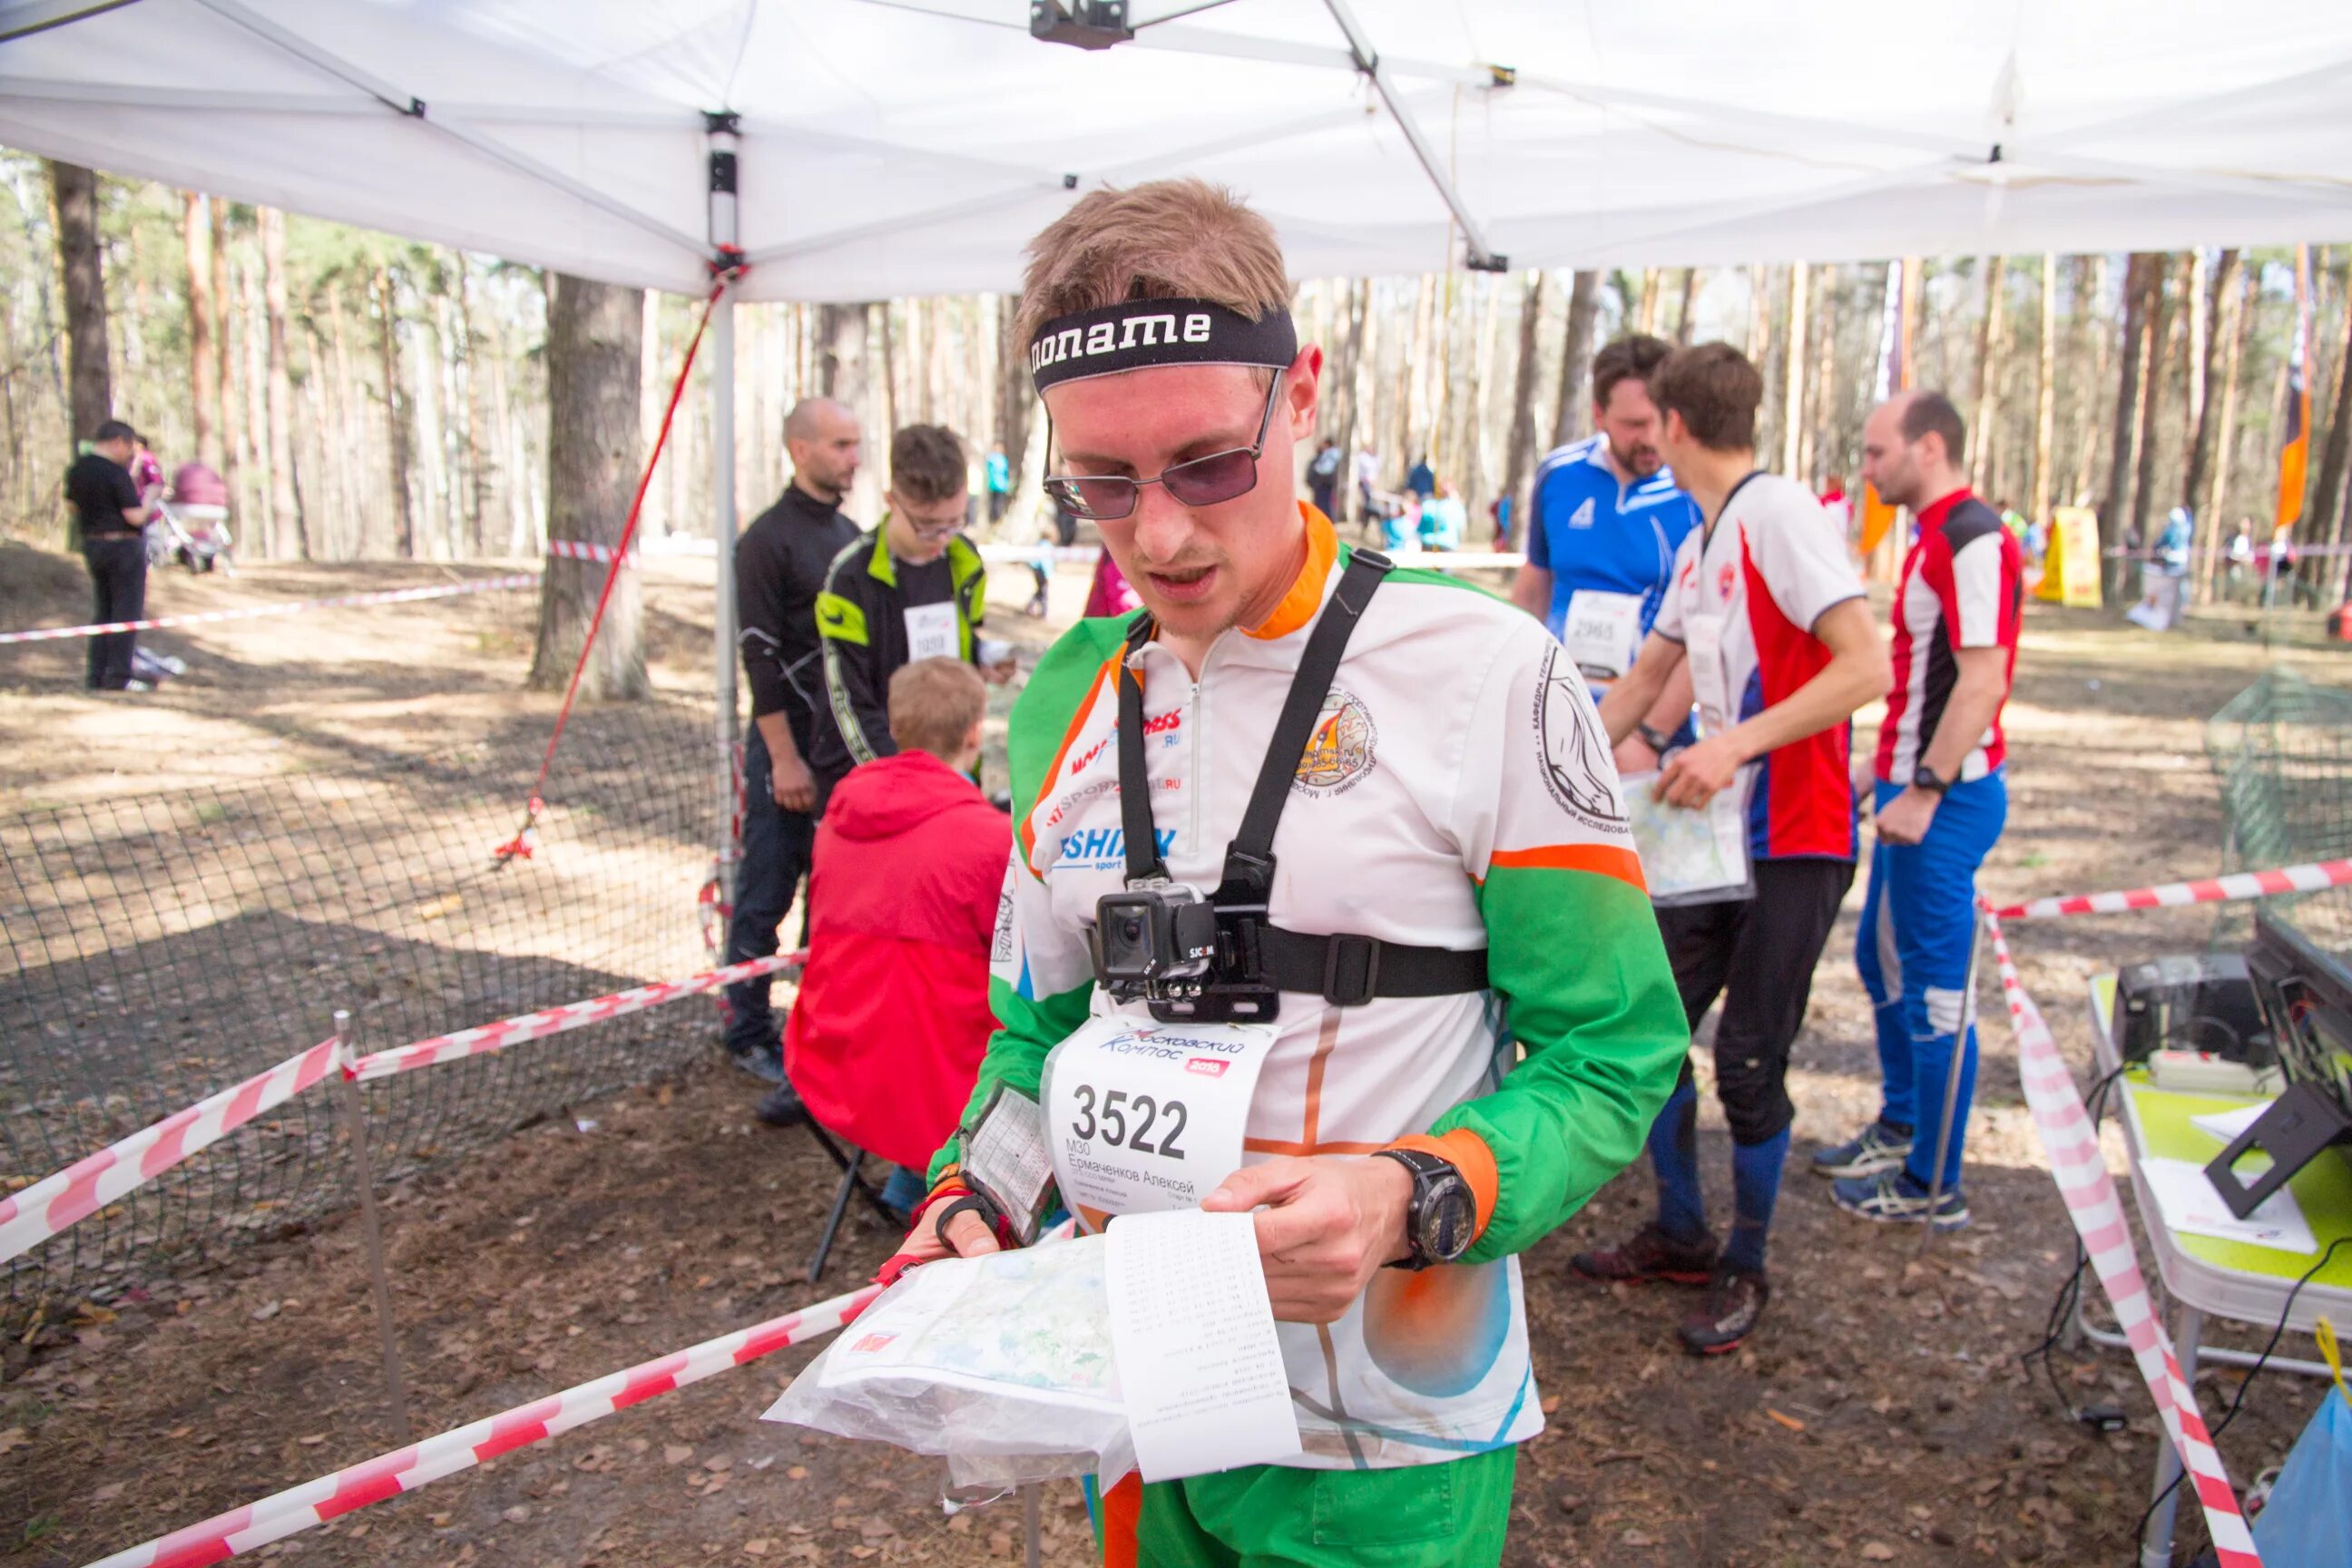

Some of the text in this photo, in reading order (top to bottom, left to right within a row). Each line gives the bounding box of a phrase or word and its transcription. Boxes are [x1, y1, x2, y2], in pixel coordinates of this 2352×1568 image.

[1031, 313, 1210, 374] noname
[1532, 681, 1544, 730] КАФЕДРА
[1535, 751, 1631, 834] НАЦИОНАЛЬНЫЙ ИССЛЕДОВА
[1095, 860, 1122, 871] sport
[1072, 1083, 1188, 1161] 3522
[1065, 1138, 1091, 1157] М30
[1068, 1153, 1141, 1181] Ермаченков
[1142, 1171, 1194, 1194] Алексей
